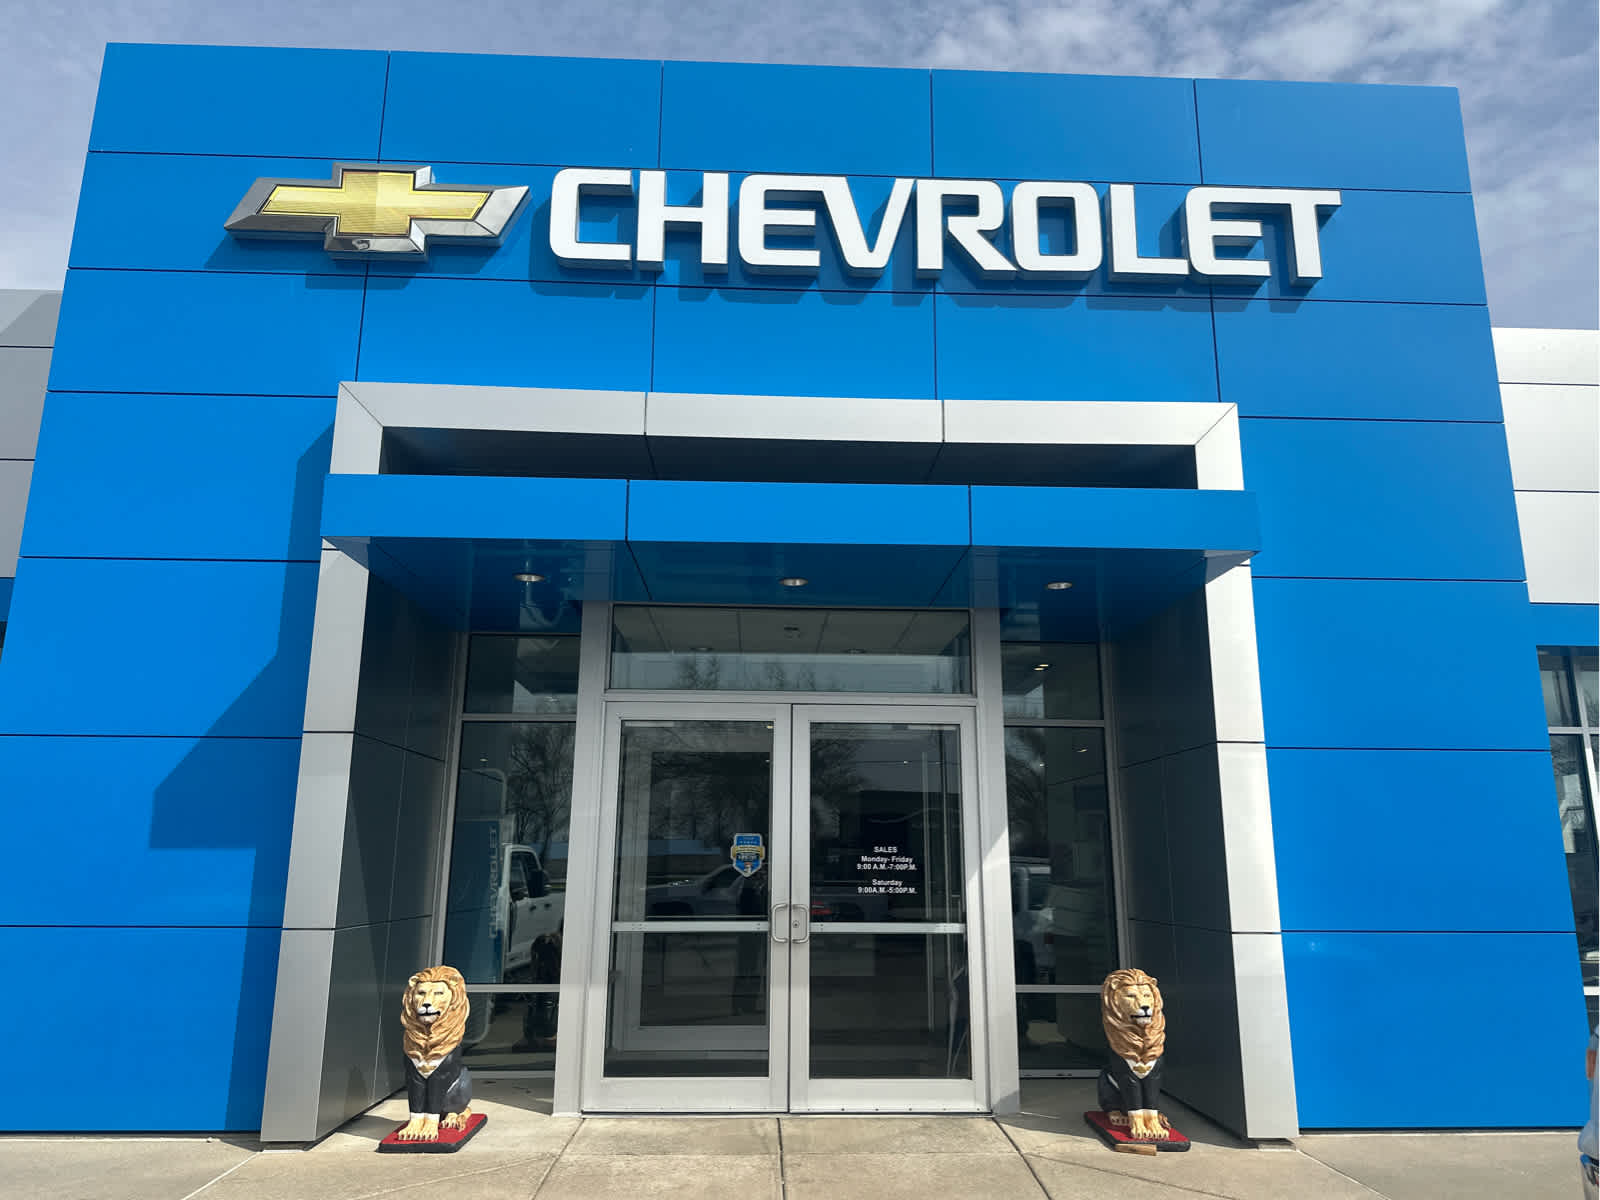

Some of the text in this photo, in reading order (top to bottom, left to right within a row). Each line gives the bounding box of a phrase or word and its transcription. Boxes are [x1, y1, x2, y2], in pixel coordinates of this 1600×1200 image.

[550, 167, 1341, 280] CHEVROLET
[891, 855, 914, 864] Friday
[872, 879, 903, 887] Saturday
